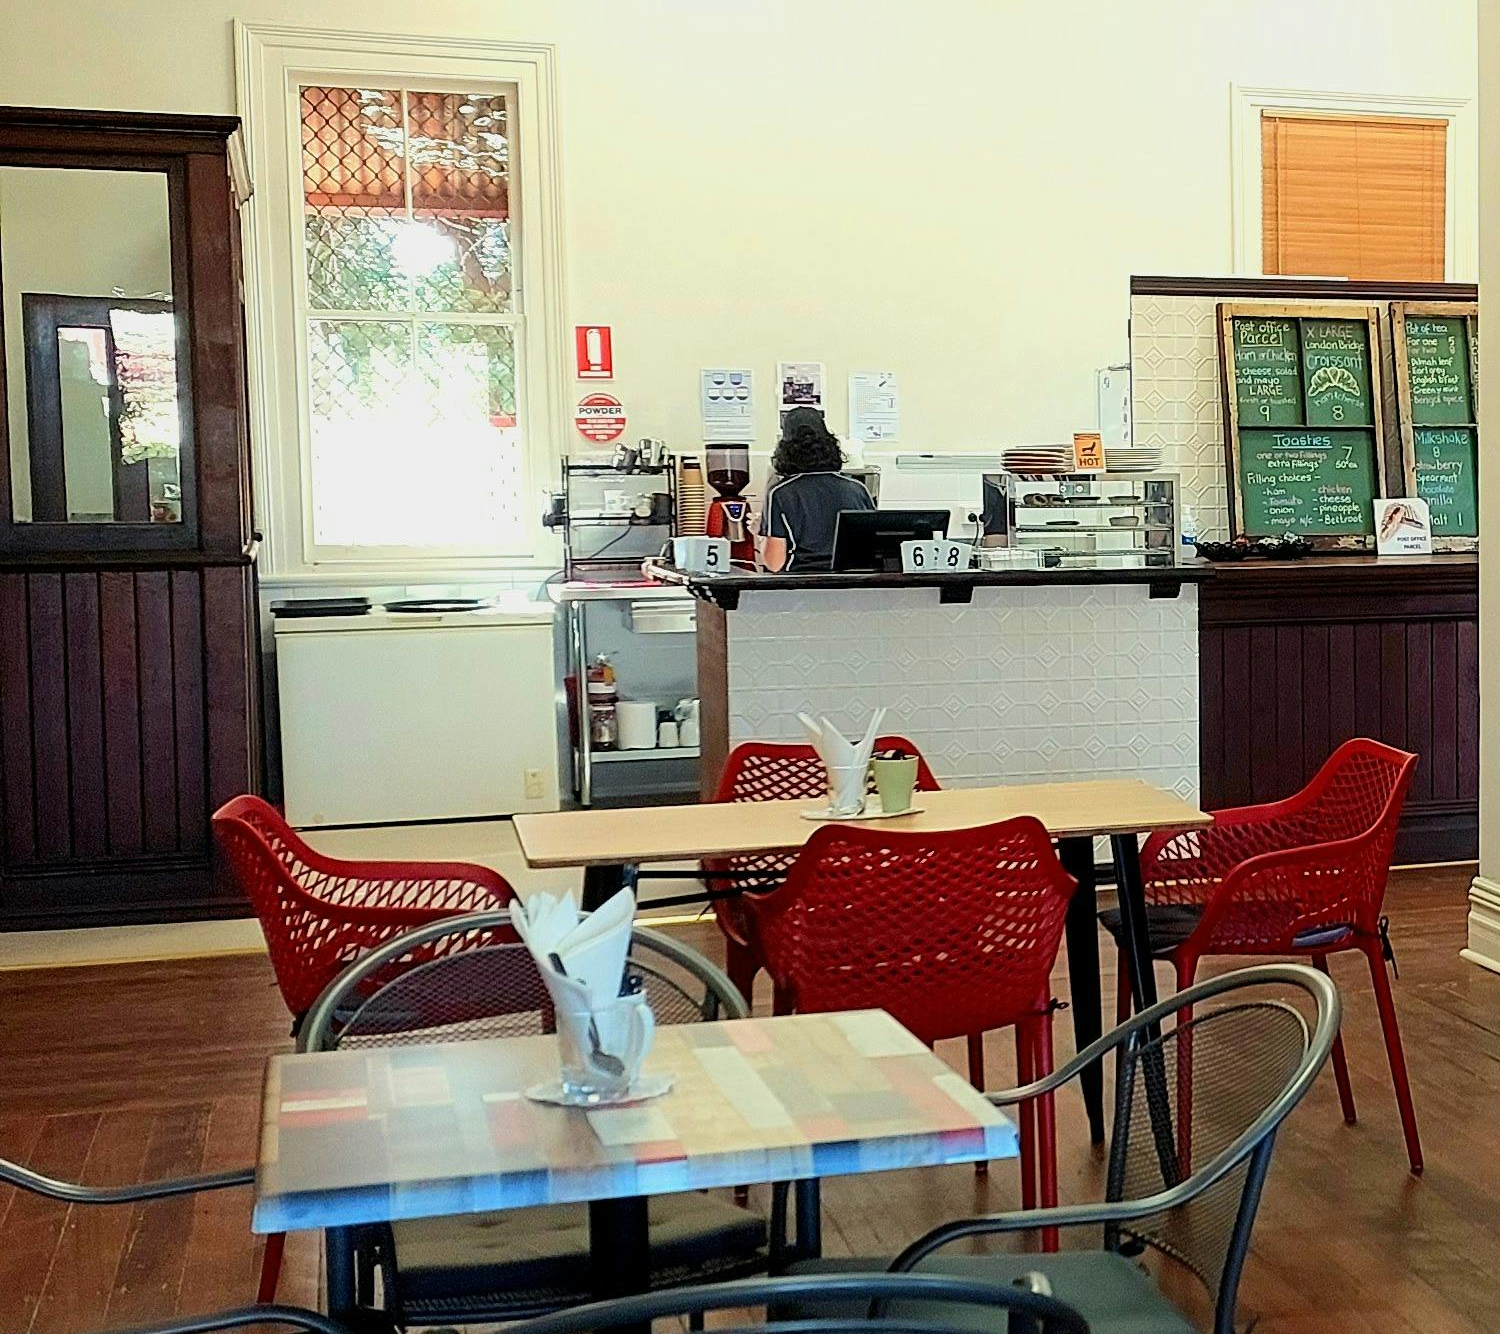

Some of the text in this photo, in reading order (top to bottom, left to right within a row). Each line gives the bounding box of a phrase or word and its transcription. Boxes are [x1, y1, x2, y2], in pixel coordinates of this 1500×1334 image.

[1234, 320, 1290, 333] Post office
[1306, 325, 1353, 340] X LARGE
[1421, 323, 1430, 334] of
[1432, 323, 1448, 333] tea
[1240, 330, 1283, 344] Parcel
[1422, 338, 1438, 346] one
[1448, 336, 1455, 346] 5
[1304, 339, 1365, 354] London Bridge
[1306, 354, 1363, 370] Croissant
[1275, 366, 1298, 376] salad
[1411, 367, 1428, 375] Earl
[1236, 375, 1280, 387] and mayo
[1249, 385, 1283, 396] LARGE
[1259, 405, 1270, 422] 9
[1332, 404, 1344, 421] 8
[1272, 433, 1332, 446] Toasties
[1414, 430, 1468, 445] Milkshake
[1256, 452, 1273, 460] one
[1341, 445, 1353, 460] 7
[1432, 446, 1440, 458] 8
[1079, 457, 1100, 466] HOT
[1267, 460, 1290, 468] extra
[1246, 472, 1276, 486] Filling
[1278, 473, 1312, 482] choices
[706, 545, 719, 566] 5
[913, 546, 960, 567] 6 8
